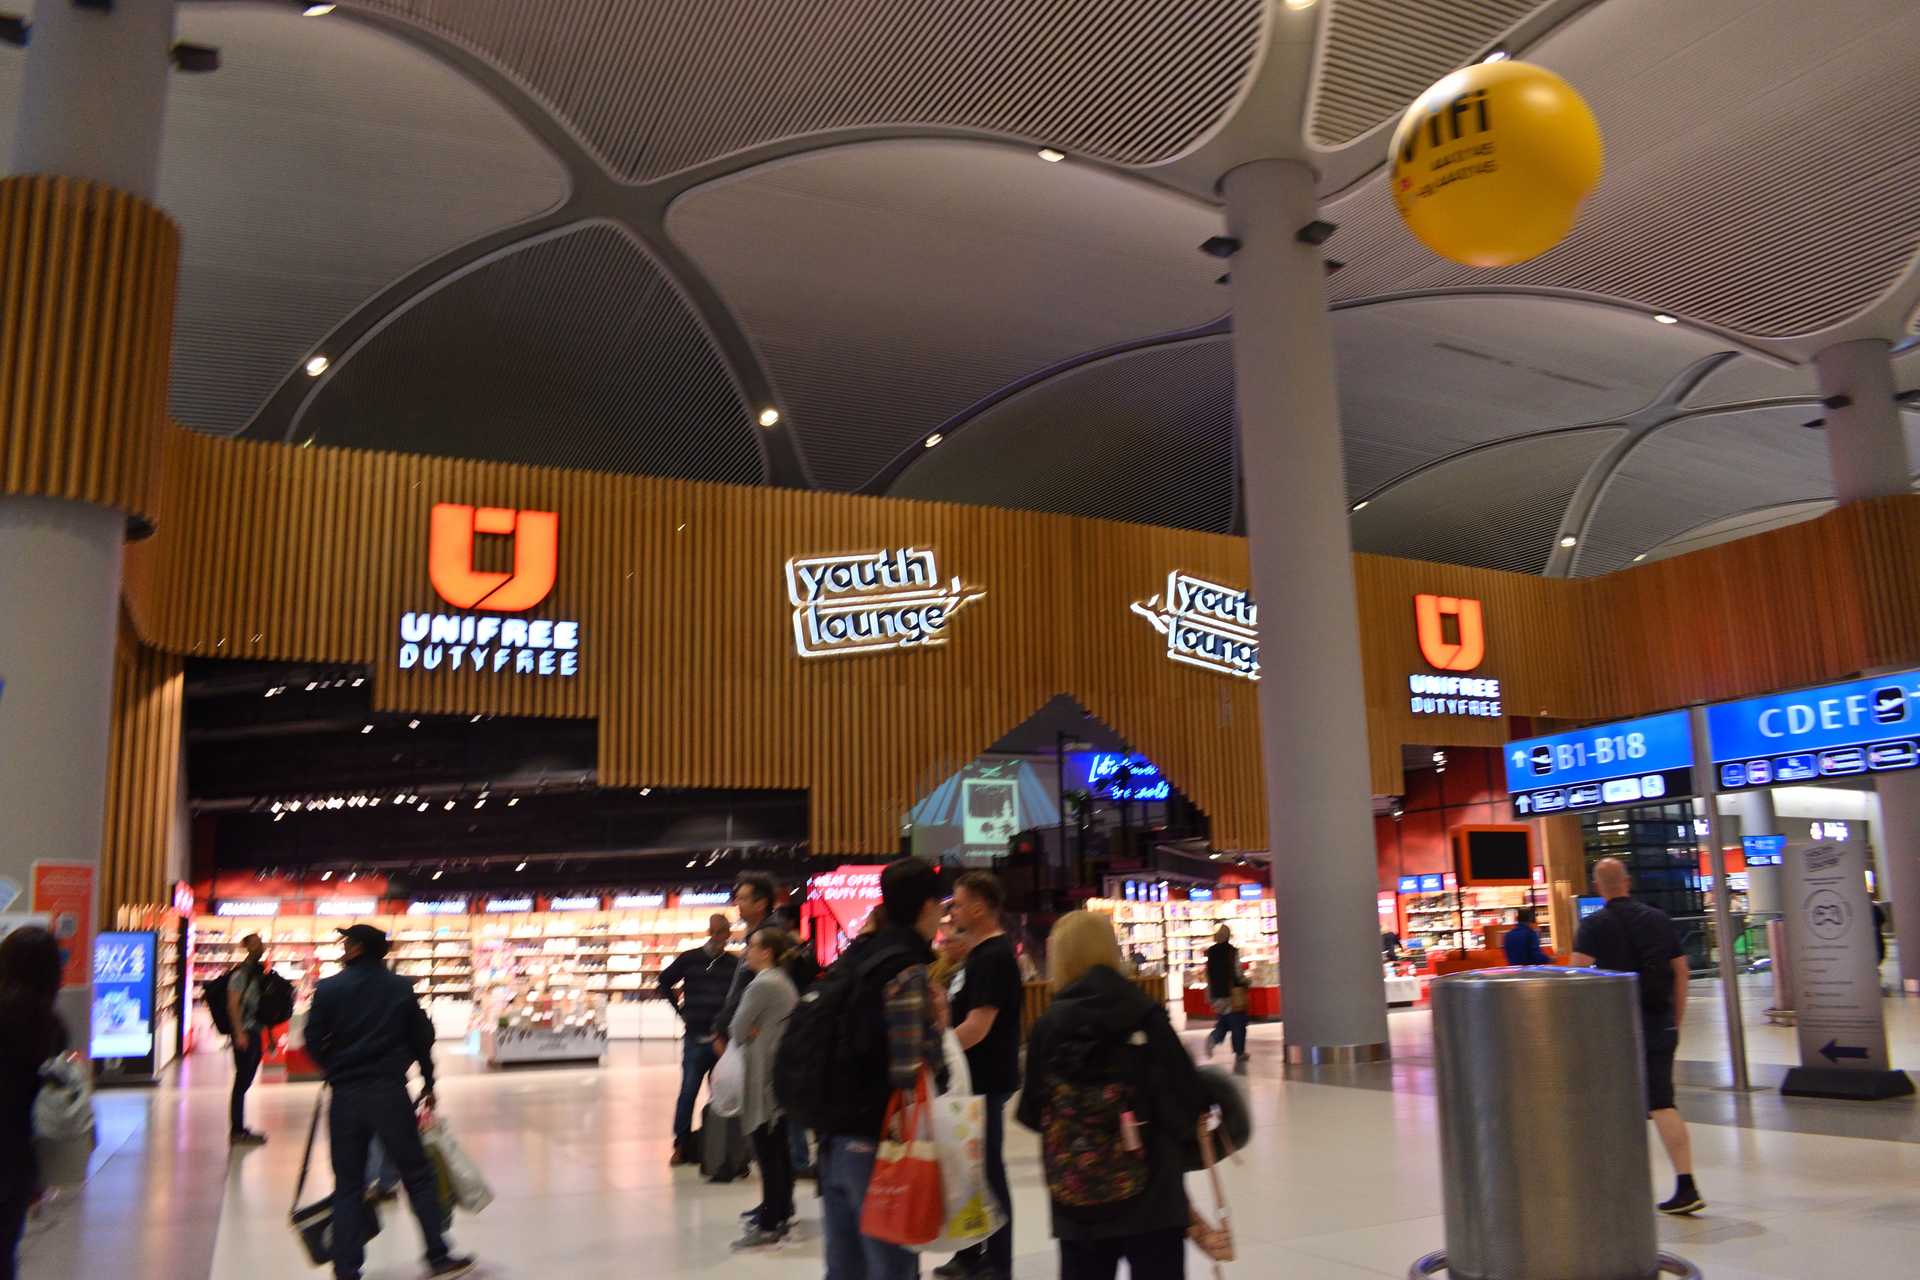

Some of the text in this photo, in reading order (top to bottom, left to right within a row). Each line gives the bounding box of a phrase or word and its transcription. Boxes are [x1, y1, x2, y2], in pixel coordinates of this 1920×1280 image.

[799, 547, 926, 606] youth
[1177, 581, 1258, 627] yout
[401, 612, 579, 650] UNIFREE
[808, 604, 946, 648] lounge
[400, 643, 578, 677] DUTYFREE
[1167, 616, 1261, 680] loung
[1409, 674, 1501, 698] UNIFREE
[1411, 697, 1502, 718] DUTYFREE
[1558, 732, 1648, 770] B1-B18
[847, 873, 881, 887] OFFE
